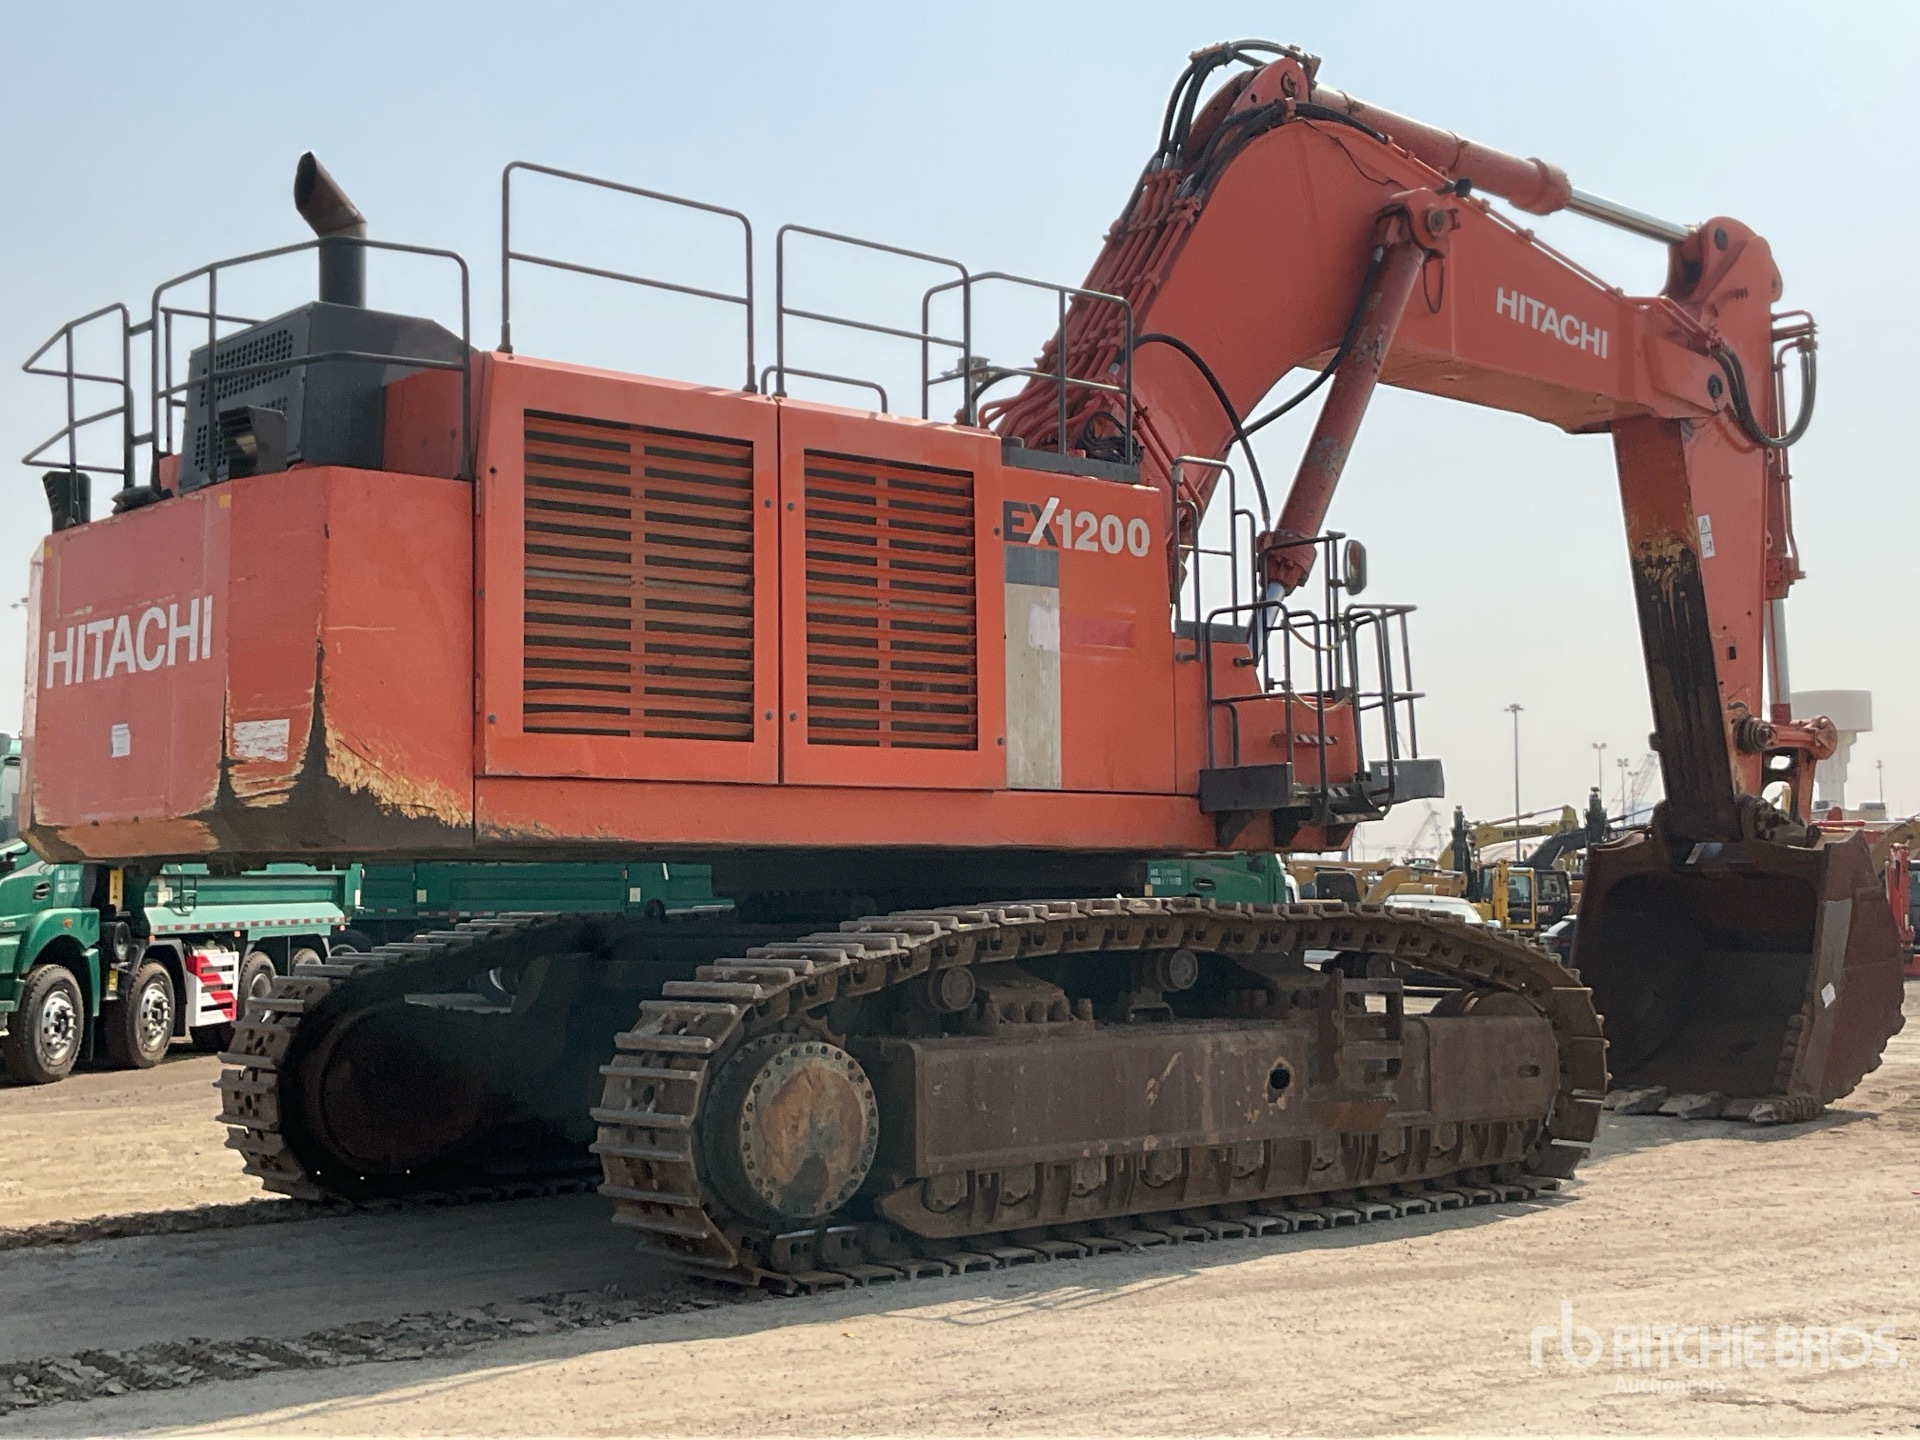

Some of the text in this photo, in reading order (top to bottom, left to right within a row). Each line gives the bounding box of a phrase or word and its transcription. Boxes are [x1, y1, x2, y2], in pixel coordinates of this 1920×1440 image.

[1496, 286, 1608, 359] HITACHI
[1002, 497, 1150, 557] EX1200
[46, 595, 213, 689] HITACHI
